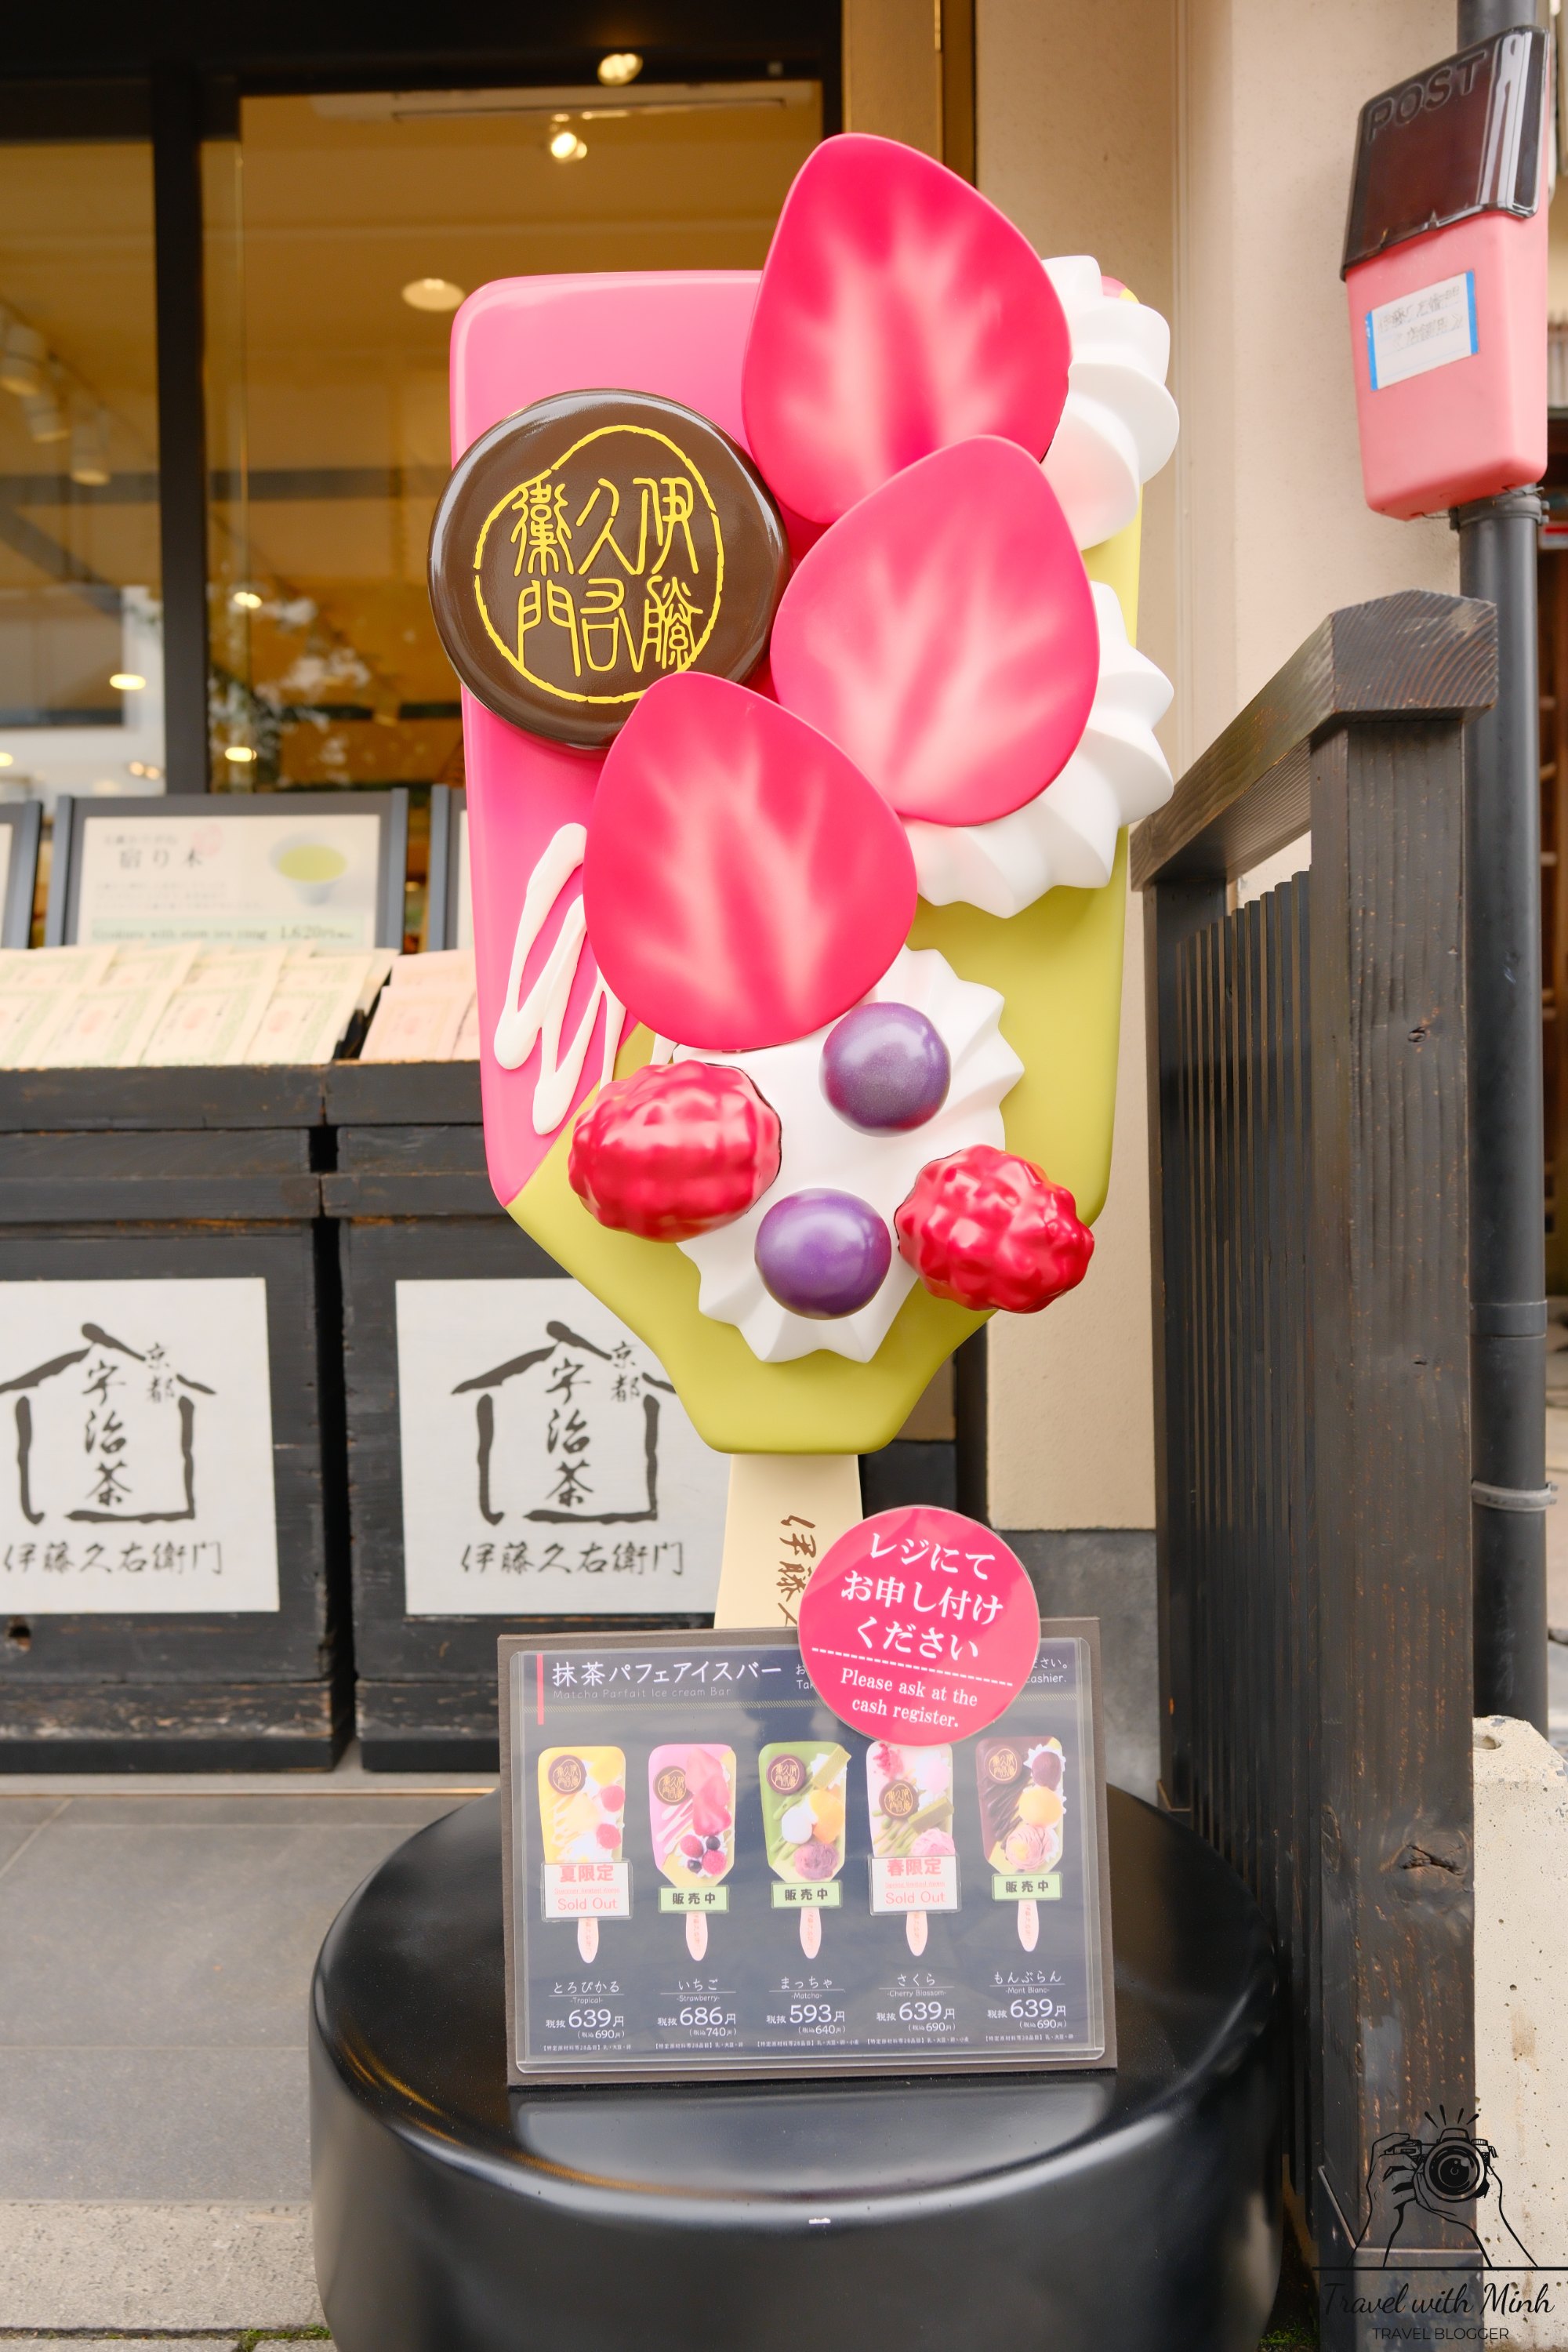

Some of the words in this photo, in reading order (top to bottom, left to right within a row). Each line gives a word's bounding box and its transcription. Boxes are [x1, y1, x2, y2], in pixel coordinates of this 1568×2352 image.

[1366, 50, 1488, 143] POST
[145, 1342, 176, 1403] 京都
[611, 1341, 641, 1403] 京都
[82, 1359, 132, 1507] 宇治茶
[545, 1357, 594, 1508] 宇治茶
[3, 1541, 223, 1575] 伊藤久右衛門
[461, 1540, 684, 1576] 伊藤久右衛門
[869, 1532, 996, 1581] レジにて
[840, 1570, 1004, 1625] お申し付け
[857, 1616, 979, 1661] ください
[1033, 1657, 1068, 1669] さい。
[552, 1660, 782, 1687] 抹茶パフェアイスバー
[553, 1690, 598, 1700] Matcha
[603, 1688, 647, 1699] Parfait
[652, 1688, 667, 1698] Ice
[671, 1688, 706, 1698] cream
[710, 1687, 731, 1697] Bar
[840, 1668, 892, 1692] Please
[898, 1681, 926, 1698] ask
[931, 1685, 947, 1702] at
[953, 1689, 978, 1707] the
[852, 1698, 887, 1716] cash
[892, 1705, 959, 1728] register.
[560, 1864, 615, 1883] 夏限定
[887, 1857, 942, 1877] 春限定
[785, 1888, 829, 1901] 販売中
[1005, 1880, 1049, 1893] 販売中
[557, 1897, 587, 1911] Sold
[592, 1896, 619, 1910] Out
[672, 1892, 716, 1905] 販売中
[885, 1892, 915, 1904] Sold
[920, 1890, 946, 1904] Out
[554, 1980, 619, 1994] とろぴかる
[678, 1978, 718, 1991] いちご
[781, 1976, 833, 1989] まっちゃ
[897, 1973, 935, 1987] さくら
[994, 1970, 1062, 1984] もんぶらん
